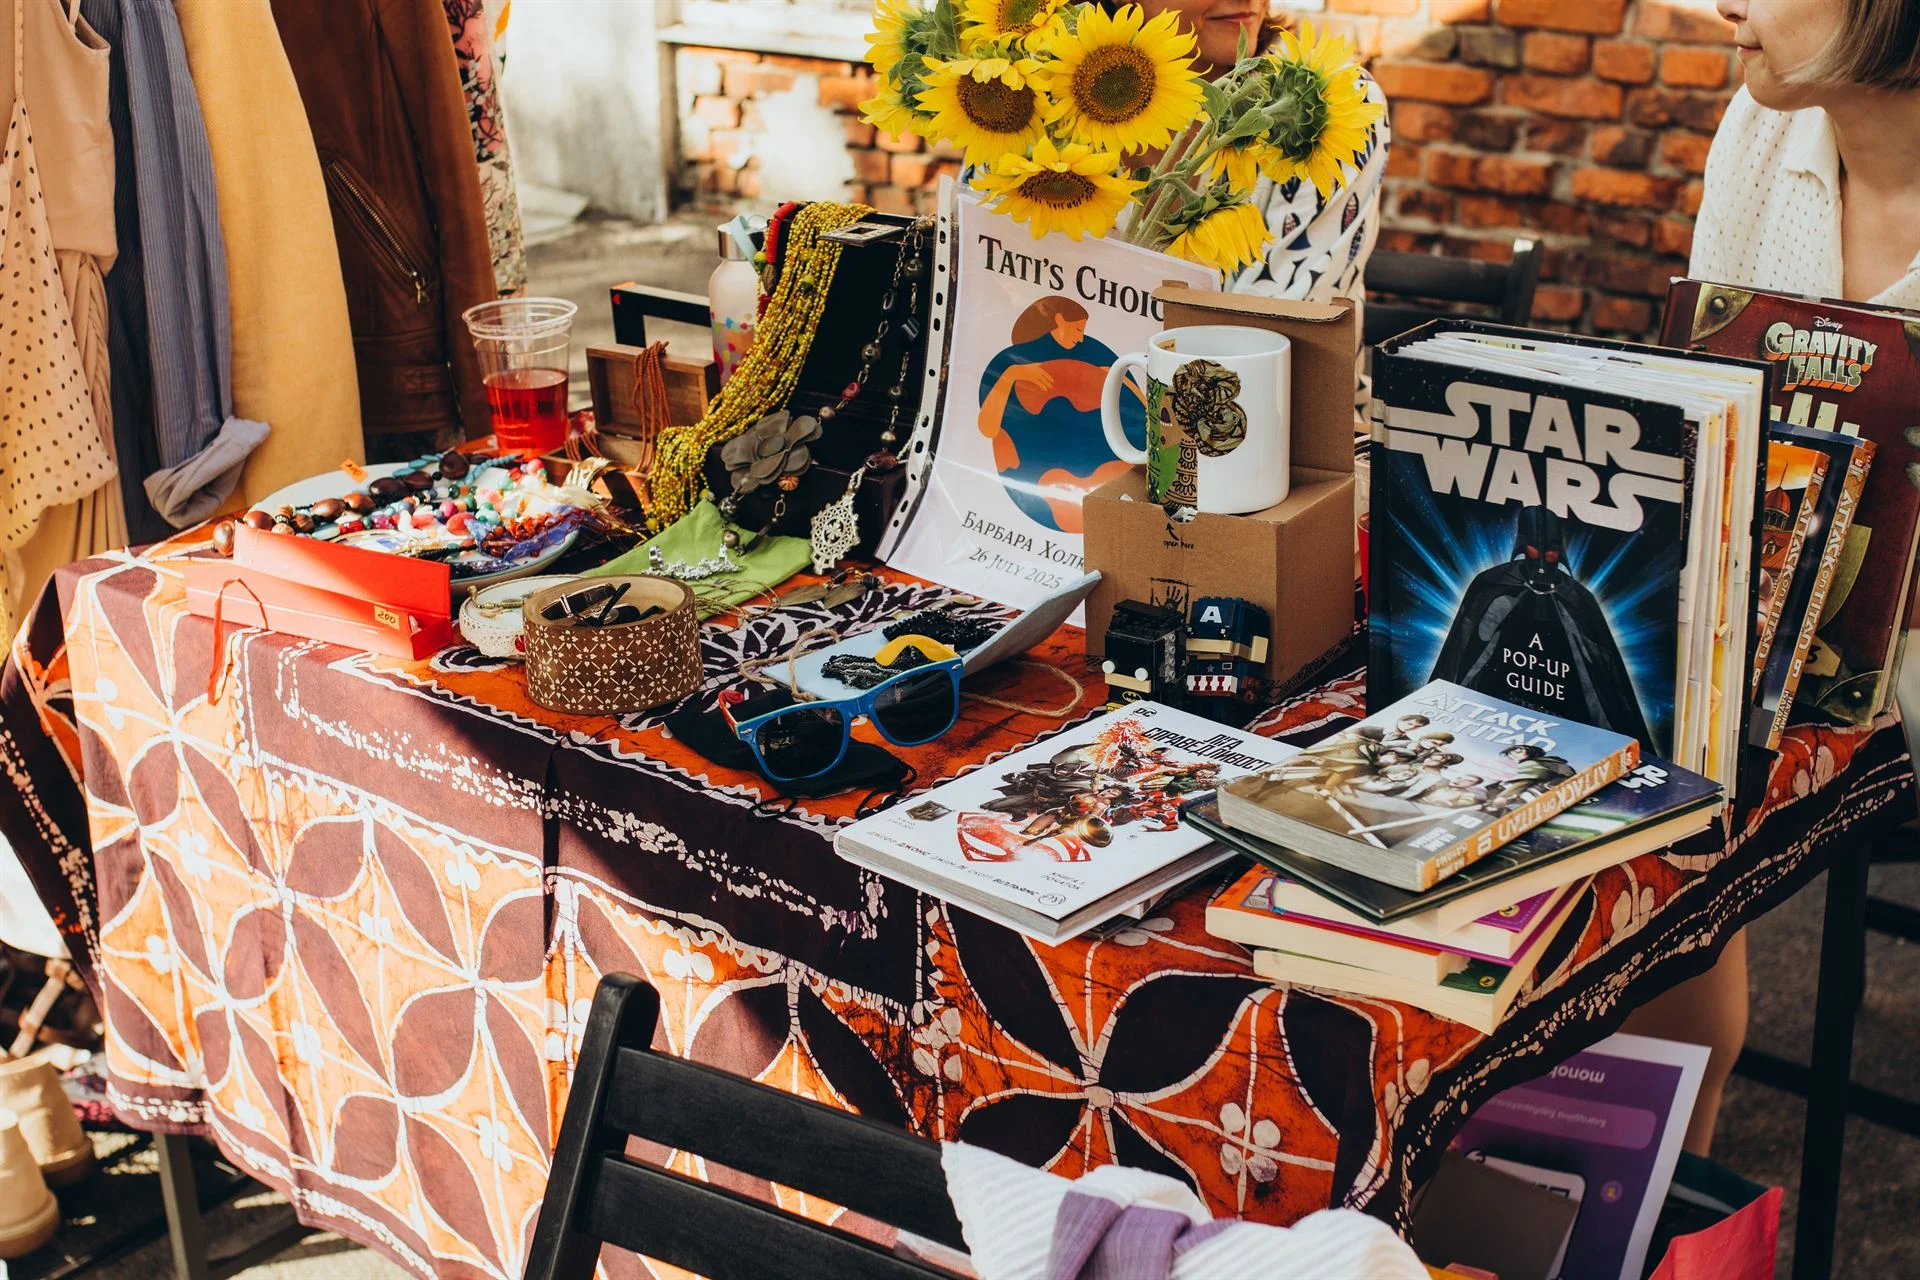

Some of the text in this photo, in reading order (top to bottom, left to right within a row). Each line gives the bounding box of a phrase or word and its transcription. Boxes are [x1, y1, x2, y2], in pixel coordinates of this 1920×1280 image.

[1076, 265, 1164, 322] CHOIC
[1812, 315, 1844, 331] Disney
[1765, 321, 1878, 370] GRAVITY
[1784, 355, 1863, 391] FALLS
[1383, 381, 1685, 480] STAR
[1383, 428, 1685, 533] WARS
[1163, 536, 1194, 549] open here
[1785, 499, 1814, 578] ATTACK
[1823, 489, 1854, 570] ATTACK
[969, 547, 1065, 590] 26 JULY 2025
[1038, 539, 1085, 571] ХОЛК
[378, 610, 396, 624] 200
[1200, 605, 1223, 624] A
[1758, 599, 1787, 660] TITAN
[1798, 591, 1826, 651] TITAN
[1528, 632, 1544, 651] A
[1503, 647, 1570, 678] POP-UP
[1792, 658, 1803, 679] 9
[1506, 672, 1565, 700] GUIDE
[1133, 707, 1157, 717] DC
[1414, 692, 1560, 736] ATTACK
[1143, 727, 1273, 771] СПРАВЕДЛИВОСТ
[1453, 718, 1557, 752] TITAN
[1556, 761, 1611, 814] ATTACK
[1498, 802, 1543, 839] TITAN
[1551, 1065, 1606, 1083] mono
